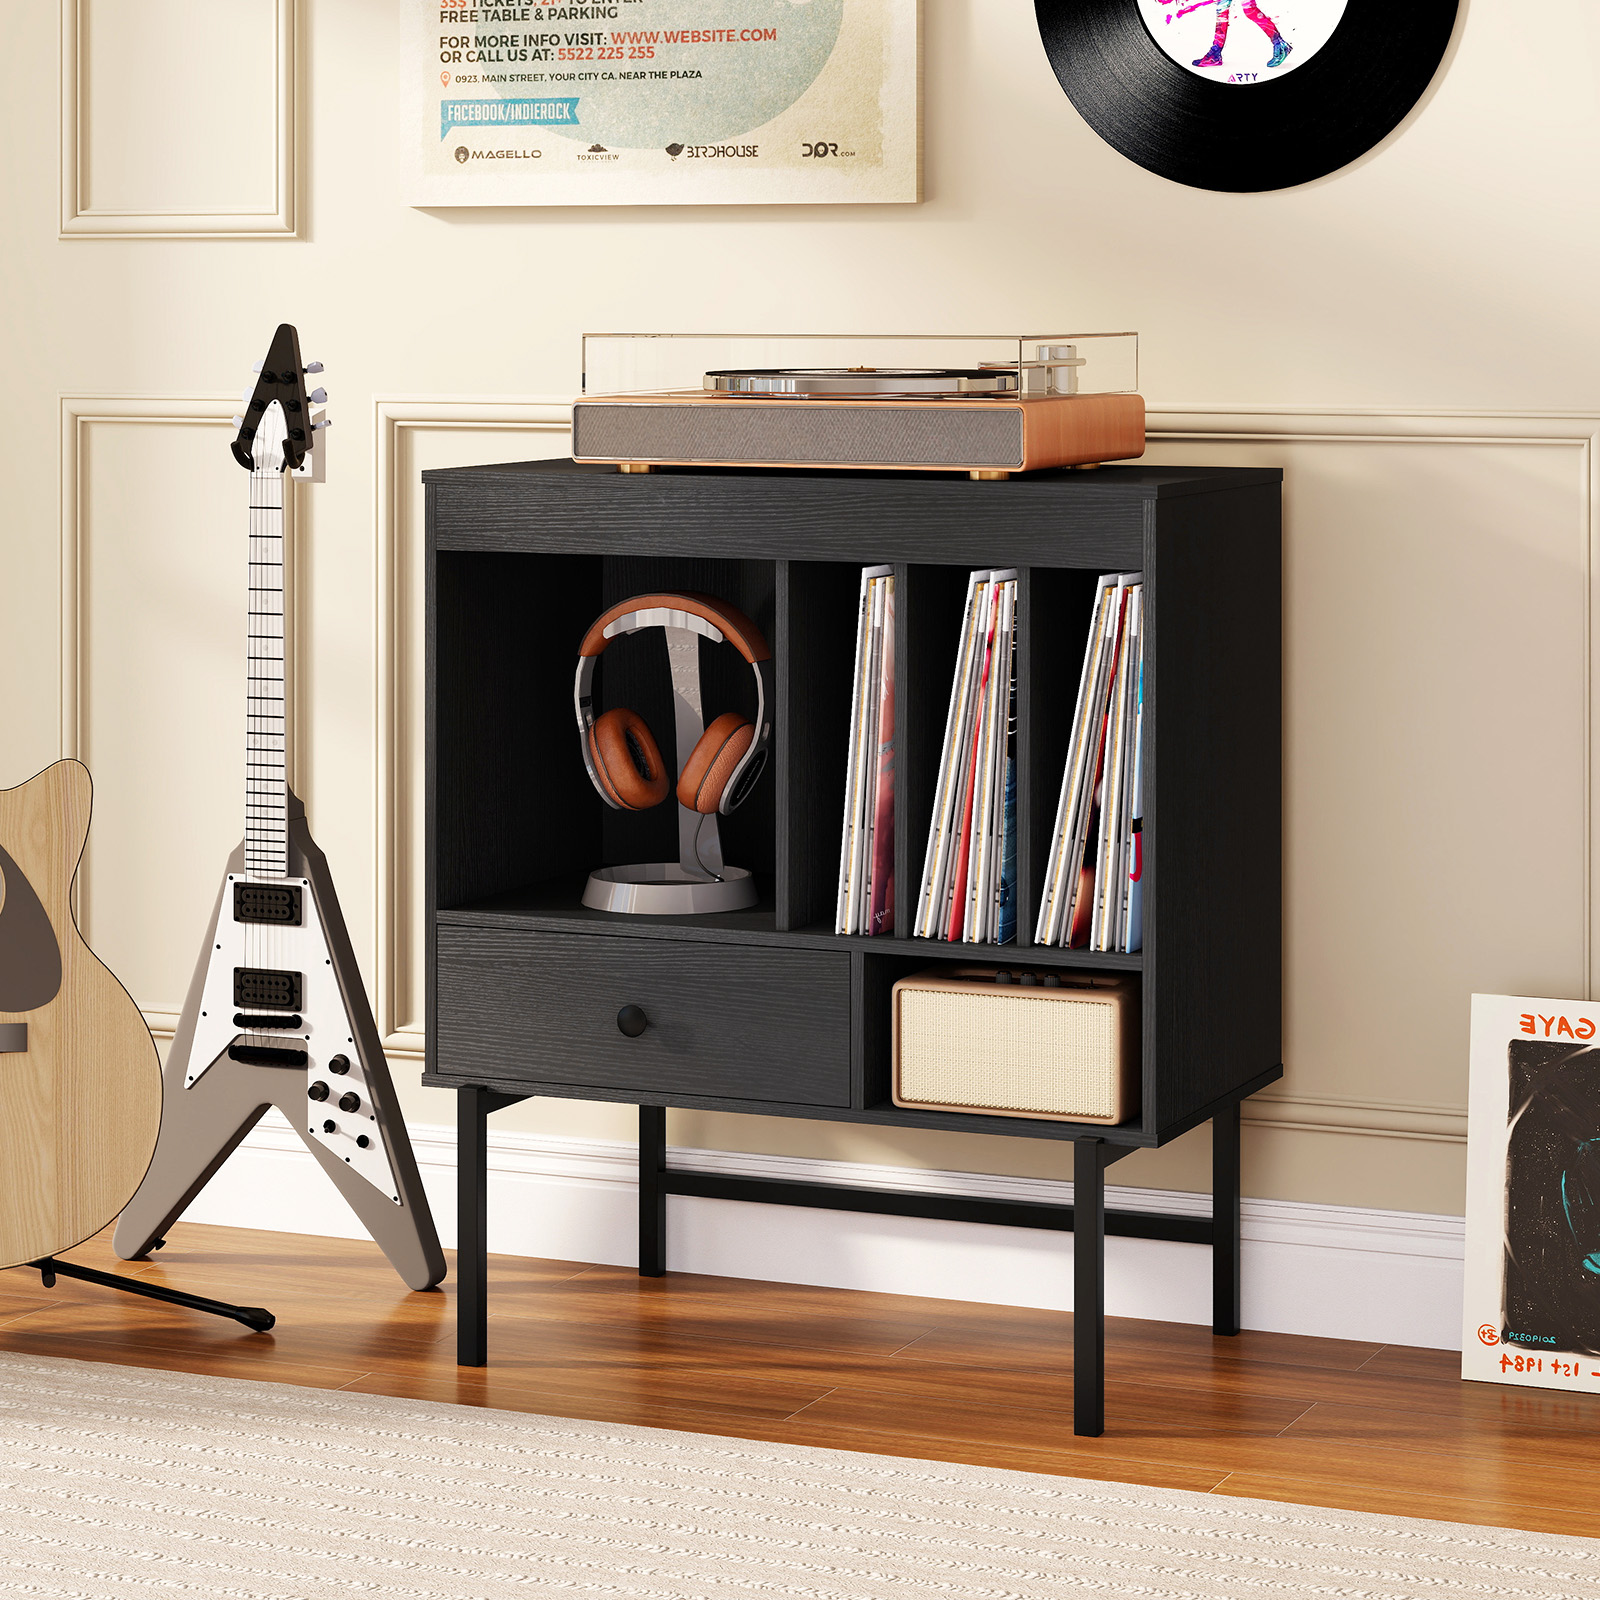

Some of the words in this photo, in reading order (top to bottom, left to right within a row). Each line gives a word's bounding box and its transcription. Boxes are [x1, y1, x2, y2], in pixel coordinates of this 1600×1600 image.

[440, 10, 478, 23] FREE
[482, 8, 530, 22] TABLE
[534, 8, 544, 20] &
[548, 6, 618, 20] PARKING
[440, 36, 470, 48] FOR
[475, 35, 519, 48] MORE
[524, 33, 560, 47] INFO
[564, 32, 608, 46] VISIT:
[611, 28, 777, 45] WWW.WEBSITE.COM
[440, 50, 462, 63] OR
[466, 49, 504, 63] CALL
[507, 49, 528, 62] US
[532, 48, 555, 61] AT:
[558, 48, 594, 61] 5522
[597, 47, 624, 60] 225
[628, 46, 655, 59] 255
[455, 75, 480, 84] 0923,
[482, 74, 507, 83] MAIN
[509, 73, 547, 83] STREET,
[549, 72, 575, 81] YOUR
[578, 72, 599, 81] CITY
[601, 72, 618, 80] CA.
[619, 71, 647, 80] NEAR
[648, 71, 668, 79] THE
[670, 70, 703, 79] PLAZA
[1227, 73, 1258, 82] ARTY
[447, 103, 571, 122] FACEBOOK/INDIEROCK
[471, 149, 542, 159] MAGELLO
[686, 145, 759, 158] BIRDHOUSE
